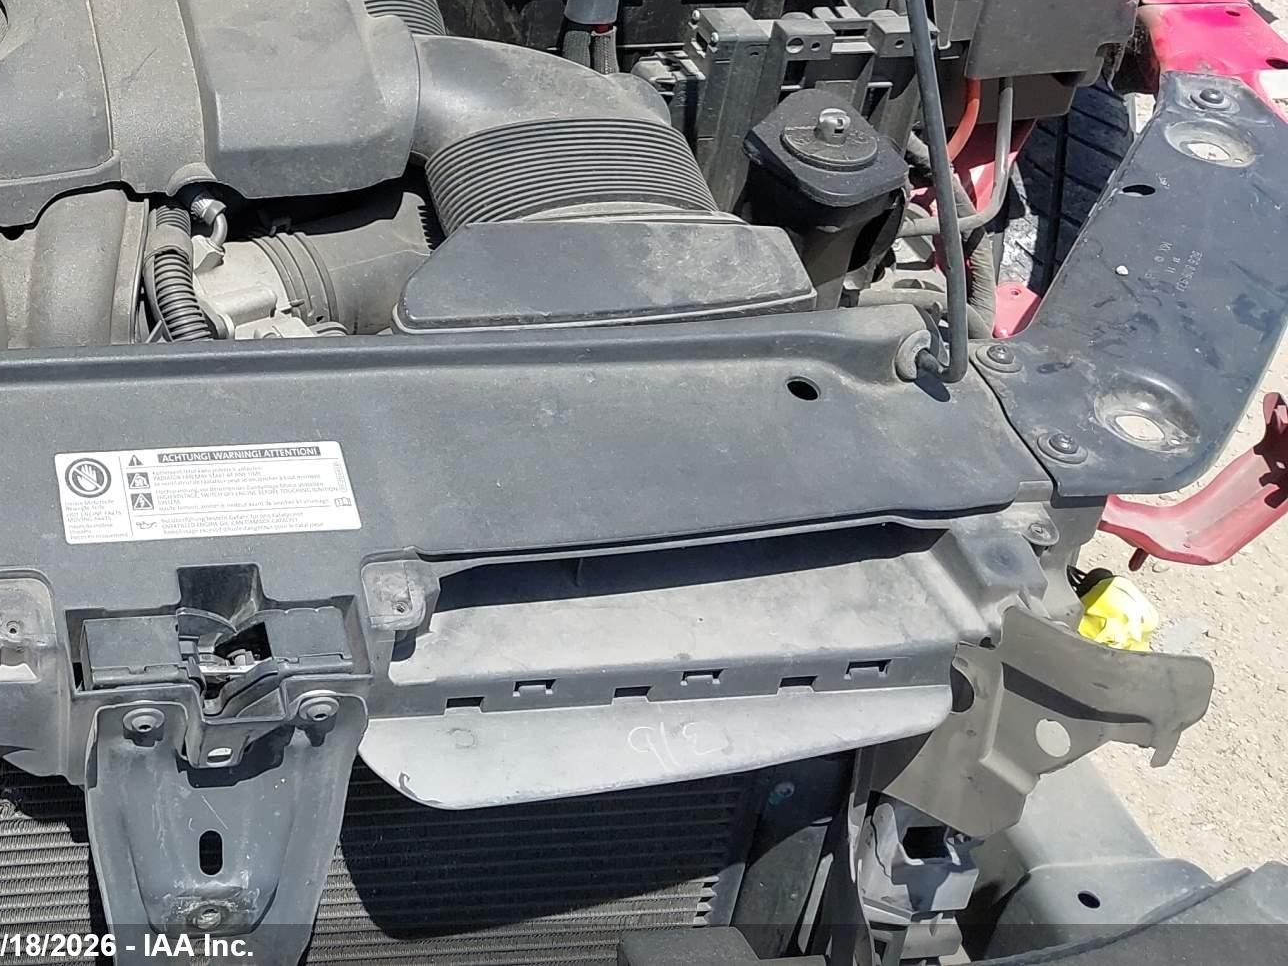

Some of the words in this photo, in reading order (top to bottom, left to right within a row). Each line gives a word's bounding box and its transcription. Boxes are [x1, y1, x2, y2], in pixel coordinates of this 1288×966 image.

[161, 452, 212, 463] ACHTUNG!
[213, 450, 262, 461] WARNING!
[264, 447, 317, 459] ATTENTION!
